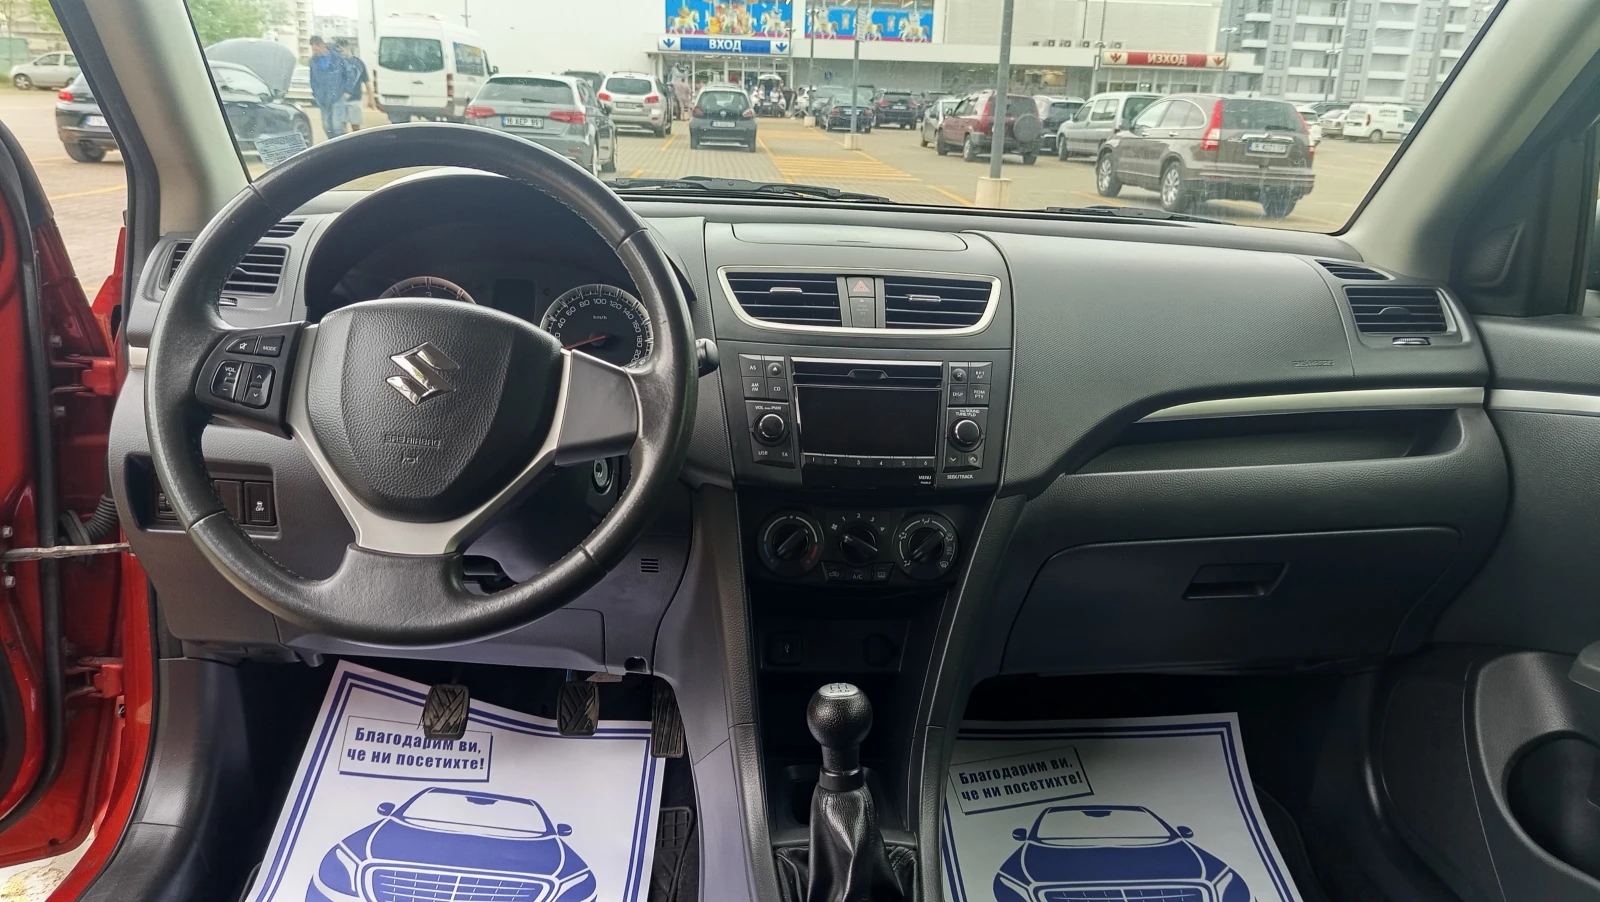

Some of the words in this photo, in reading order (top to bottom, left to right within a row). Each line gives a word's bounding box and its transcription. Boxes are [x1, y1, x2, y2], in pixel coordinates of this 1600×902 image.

[709, 39, 742, 52] ВХОД
[1147, 53, 1187, 66] ИЗХОД
[579, 299, 590, 308] 80
[609, 300, 622, 310] 120
[566, 306, 577, 316] 60
[623, 308, 634, 320] 140
[557, 317, 566, 329] 40
[632, 319, 642, 333] 160
[354, 727, 454, 752] Благодарим
[458, 740, 482, 754] ви,
[347, 748, 366, 762] че
[371, 751, 392, 764] ни
[396, 753, 485, 770] посетихте!
[958, 760, 1048, 785] Благодарим
[1050, 757, 1073, 771] ви,
[961, 789, 980, 802] че
[982, 786, 1002, 799] ни
[1003, 770, 1083, 796] посетихте!
